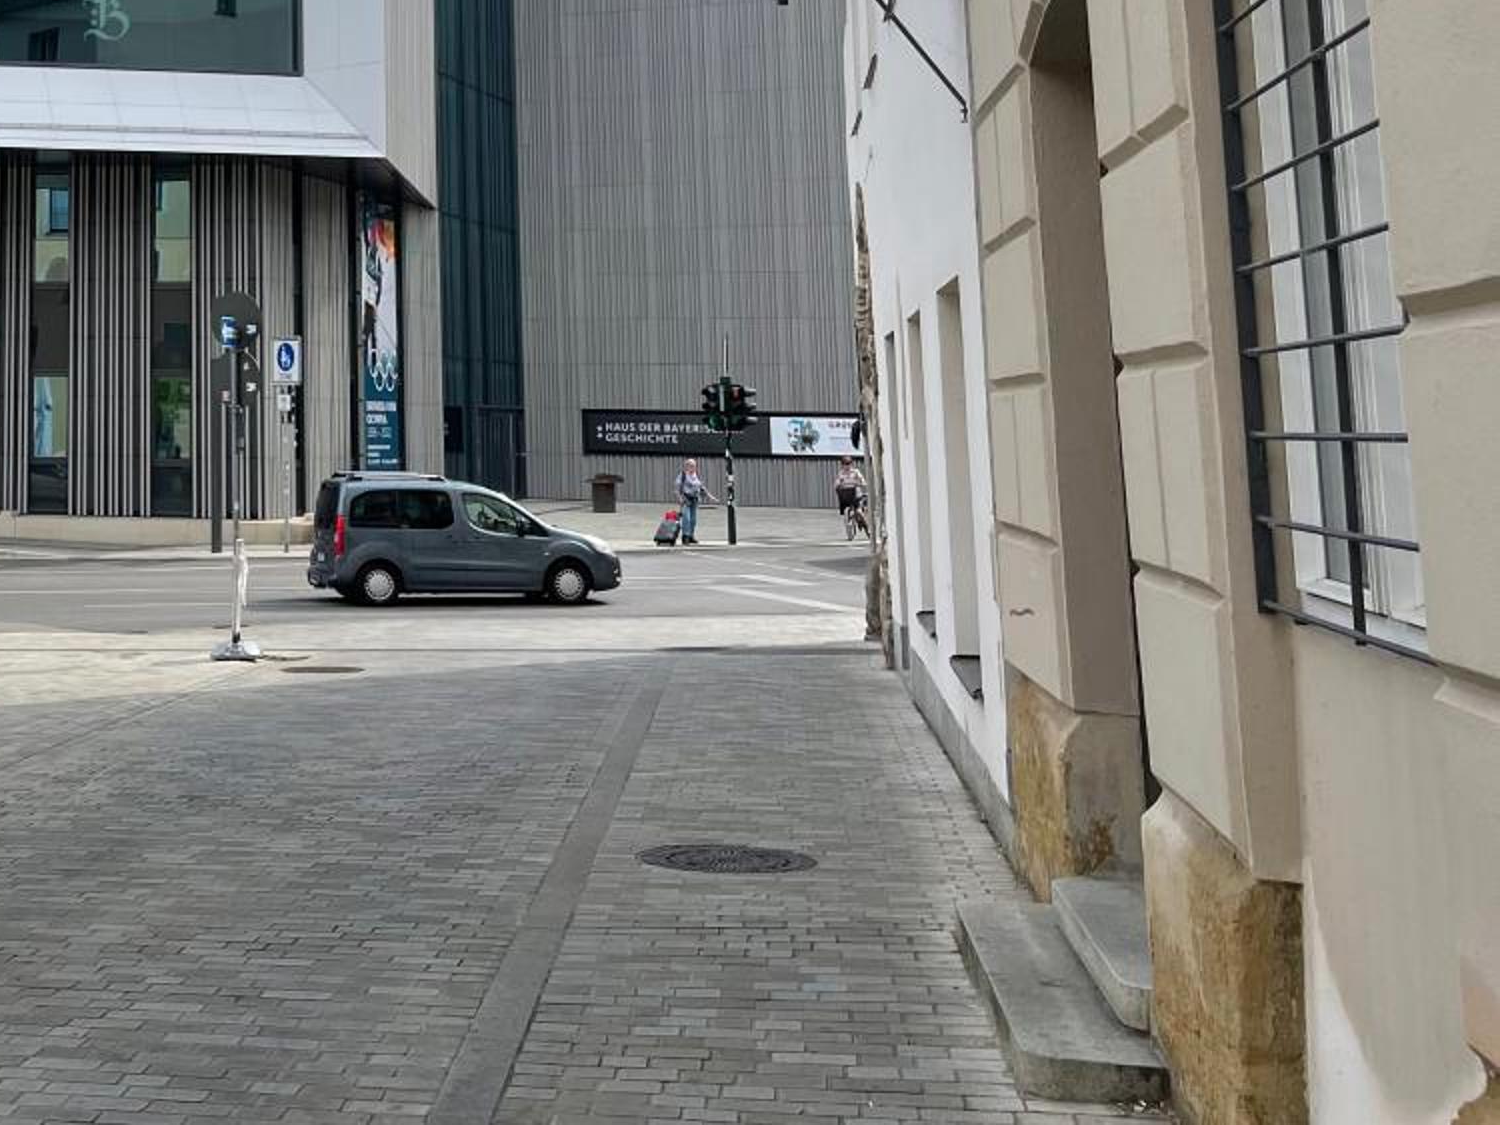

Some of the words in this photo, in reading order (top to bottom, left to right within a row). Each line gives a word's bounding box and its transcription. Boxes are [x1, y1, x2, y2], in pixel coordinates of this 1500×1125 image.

[605, 422, 635, 432] HAUS
[638, 422, 661, 432] DER
[605, 432, 678, 444] GESCHICHTE
